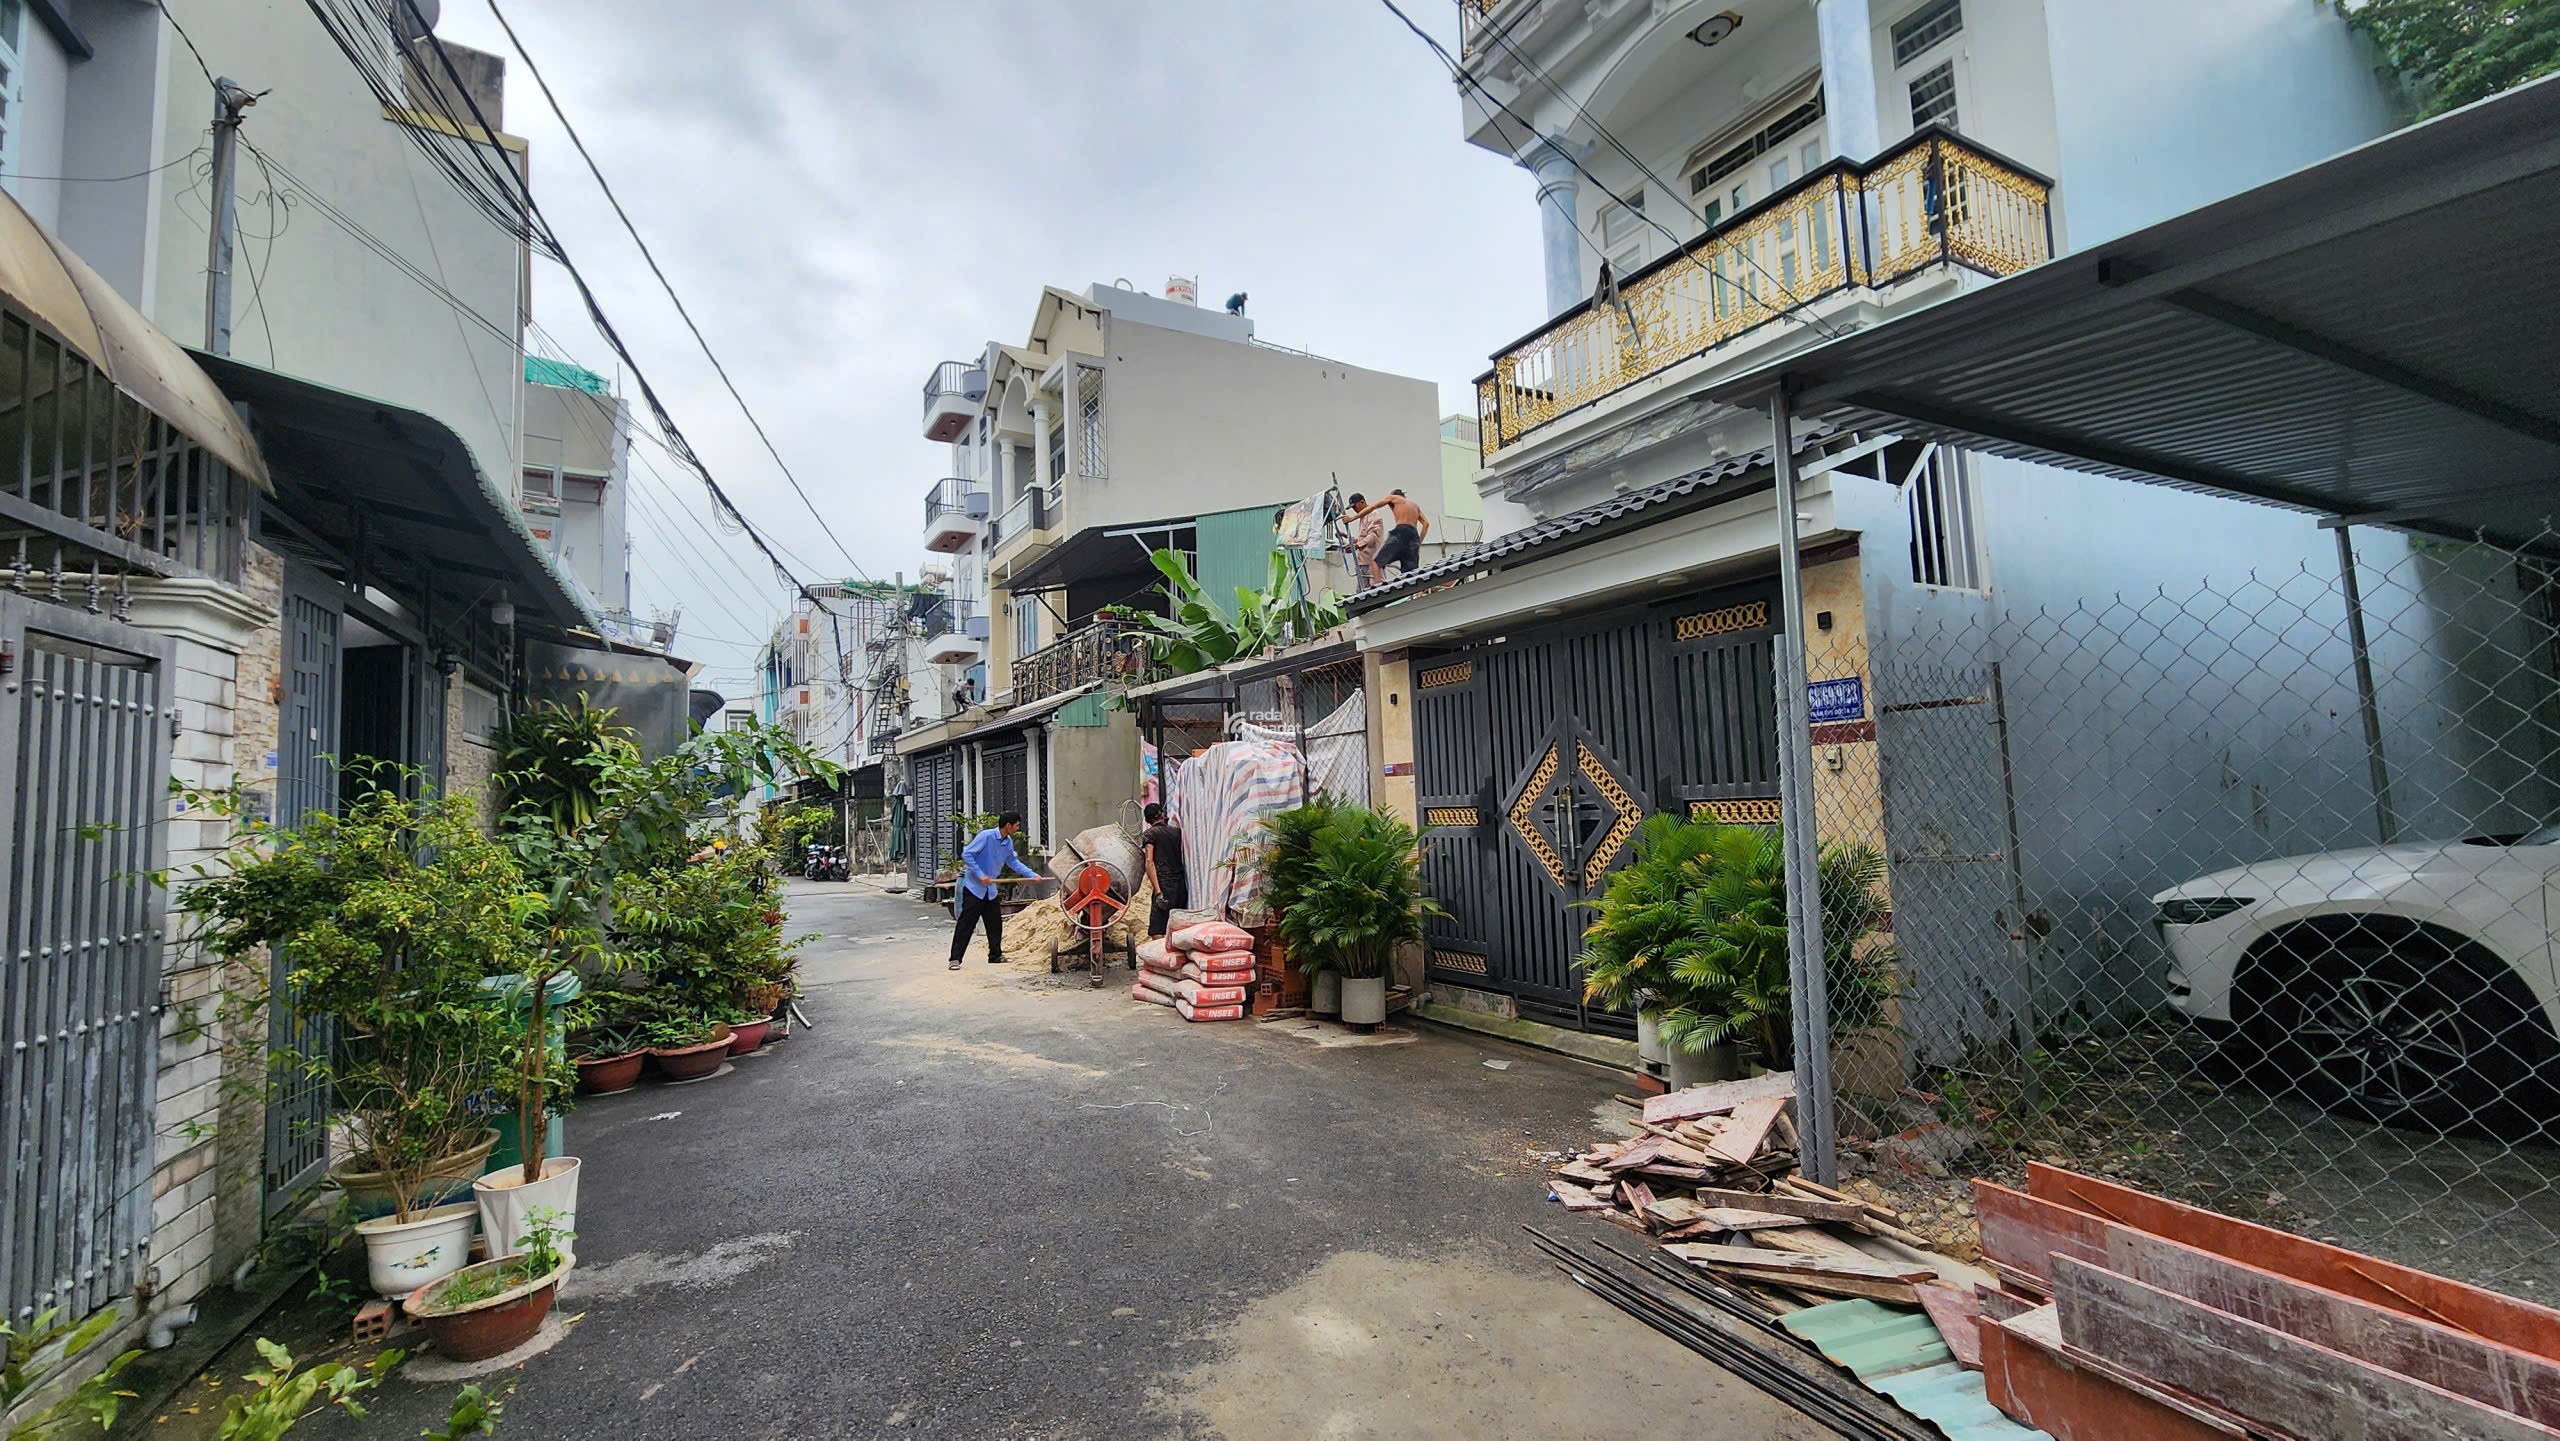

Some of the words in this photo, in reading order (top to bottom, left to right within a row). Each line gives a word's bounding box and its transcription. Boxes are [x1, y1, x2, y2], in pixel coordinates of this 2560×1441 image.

[1222, 957, 1246, 967] INSEE
[1211, 991, 1237, 1000] INSEE
[1208, 1009, 1234, 1018] INSEE
